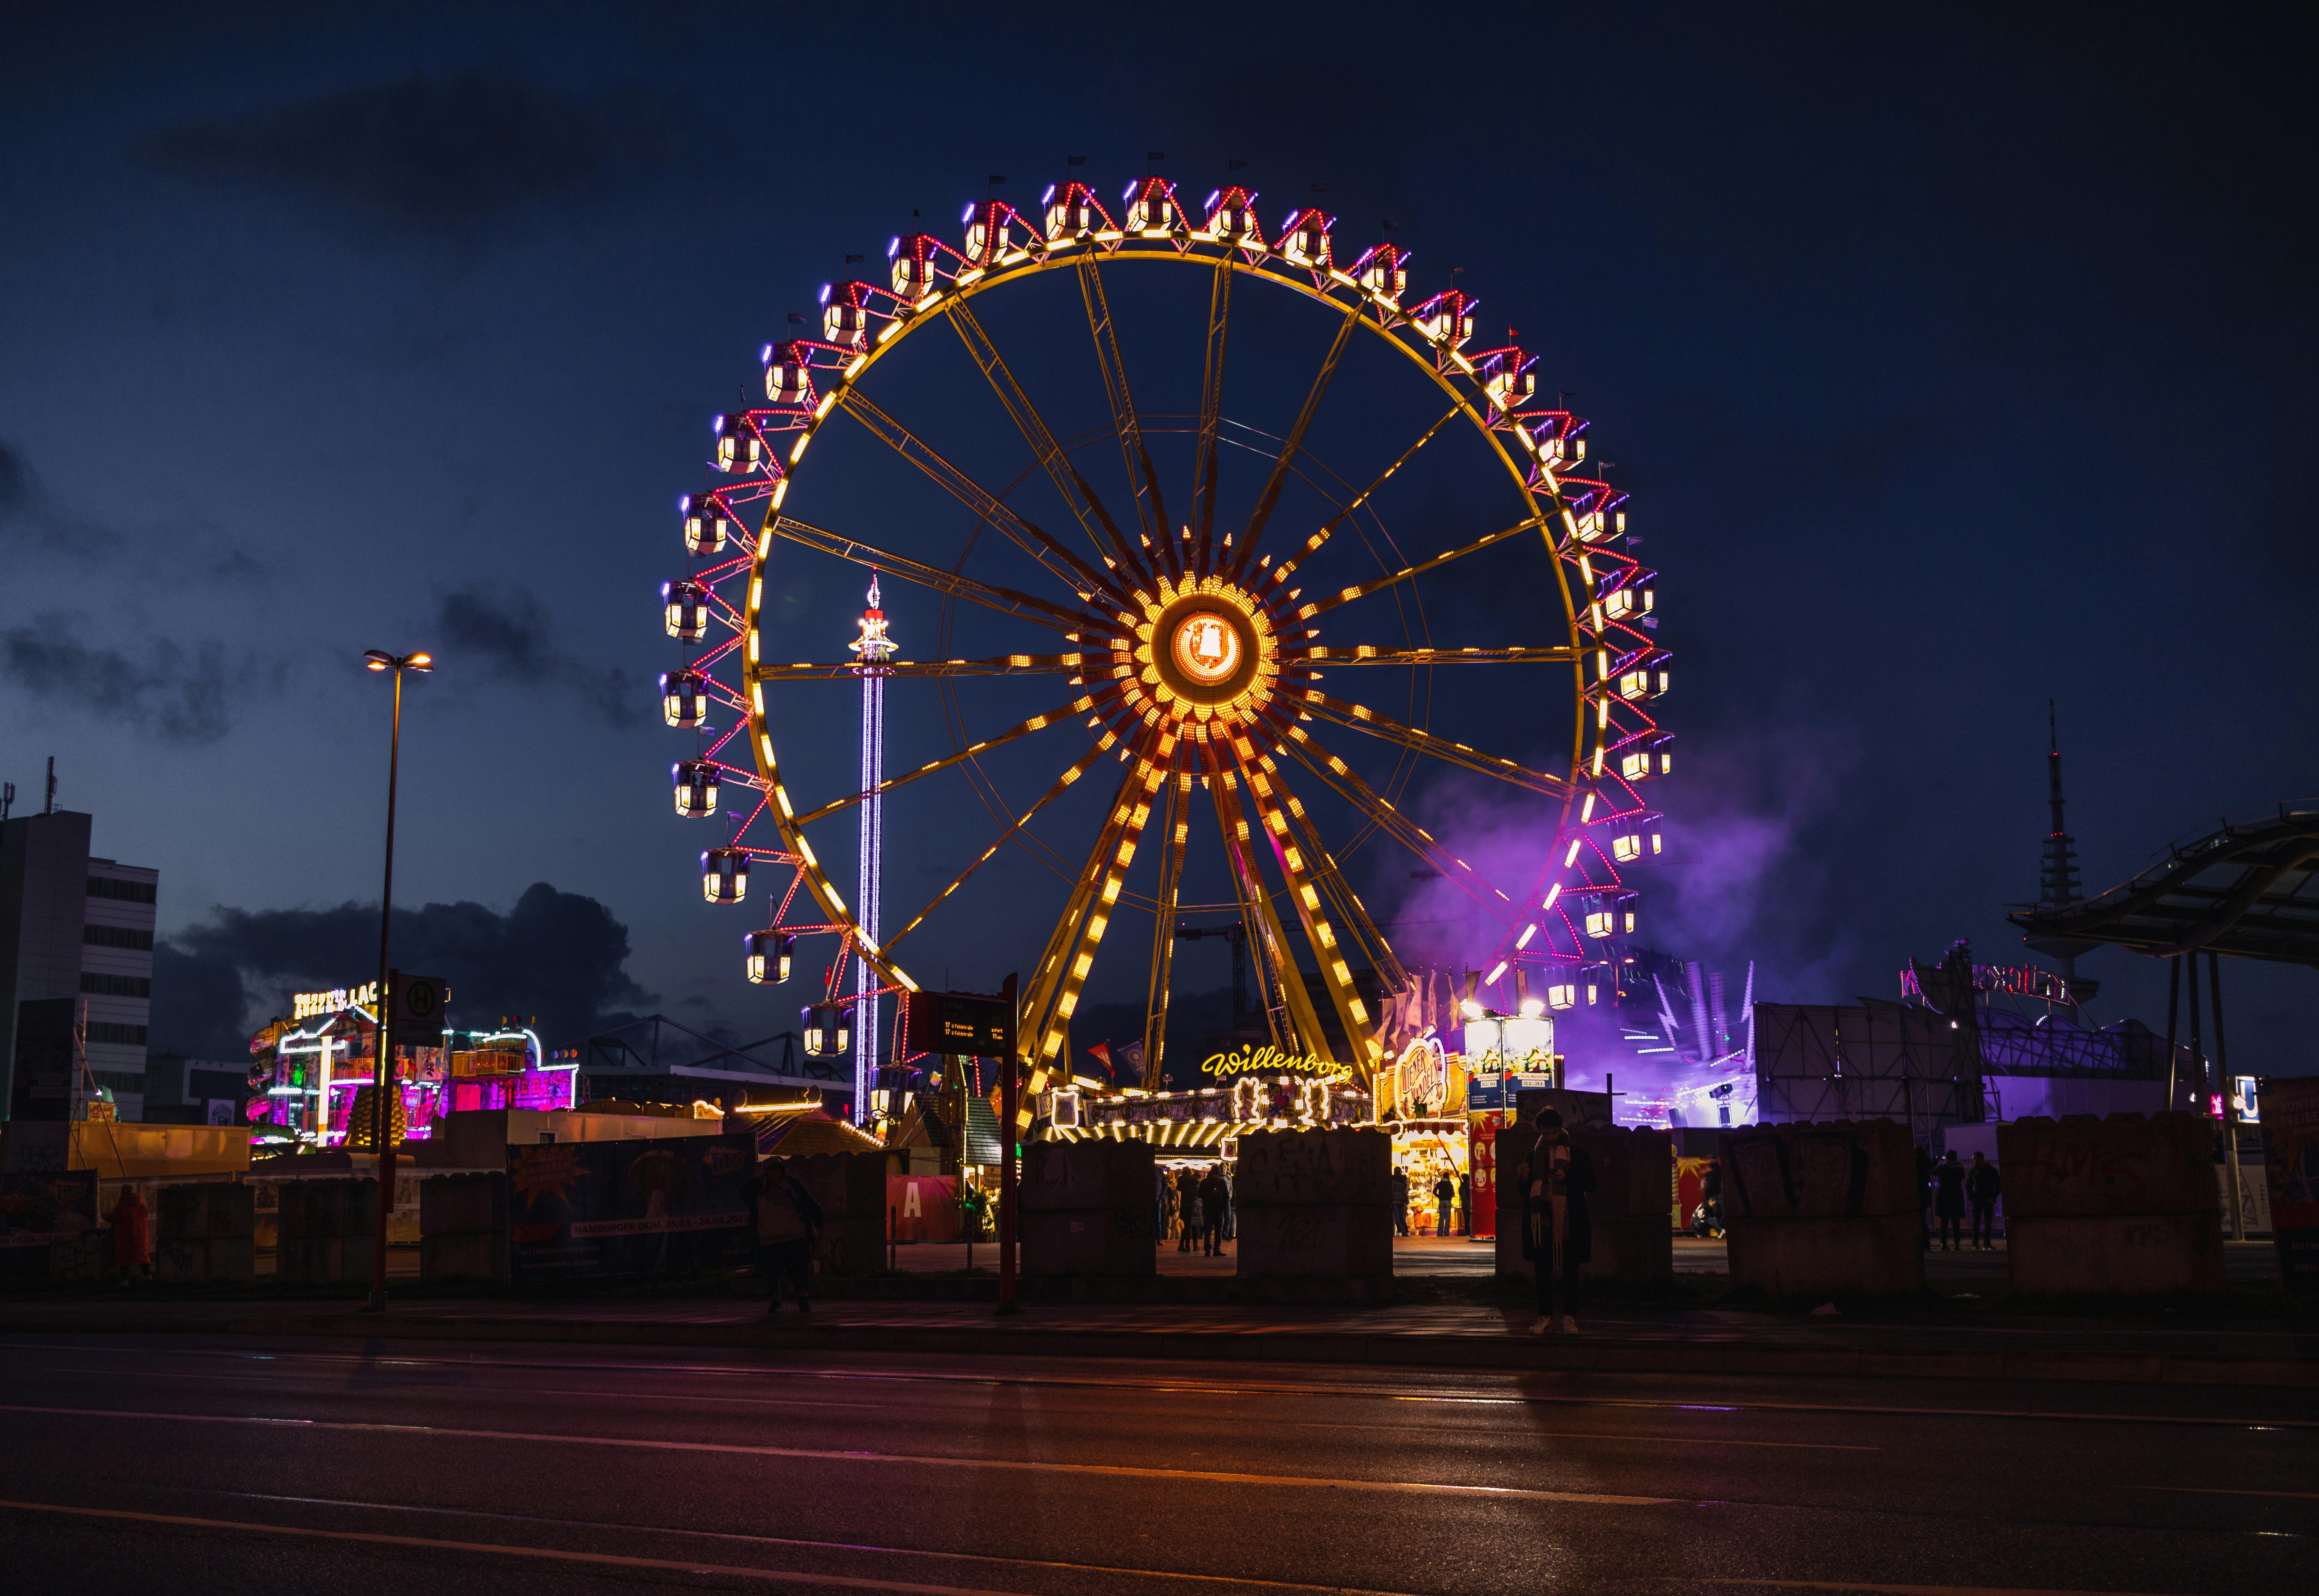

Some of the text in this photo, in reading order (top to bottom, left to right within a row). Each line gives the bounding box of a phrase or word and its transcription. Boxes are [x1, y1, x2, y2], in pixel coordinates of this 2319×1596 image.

[294, 980, 388, 1020] FUZZY'S LAC
[415, 990, 428, 1009] H
[1202, 1044, 1353, 1083] Willenborg
[1401, 1049, 1427, 1092] WIENER
[1411, 1059, 1439, 1105] MANDELN
[2240, 1081, 2258, 1118] U
[2280, 1110, 2319, 1126] TREIBE
[904, 1182, 922, 1217] A
[575, 1224, 636, 1235] HAMBURGER
[638, 1221, 661, 1233] DOM
[561, 1245, 601, 1254] FAMILIENTAG
[2291, 1241, 2319, 1250] MITTW
[521, 1259, 599, 1269] WWW.HAMBURG.DE/DOM
